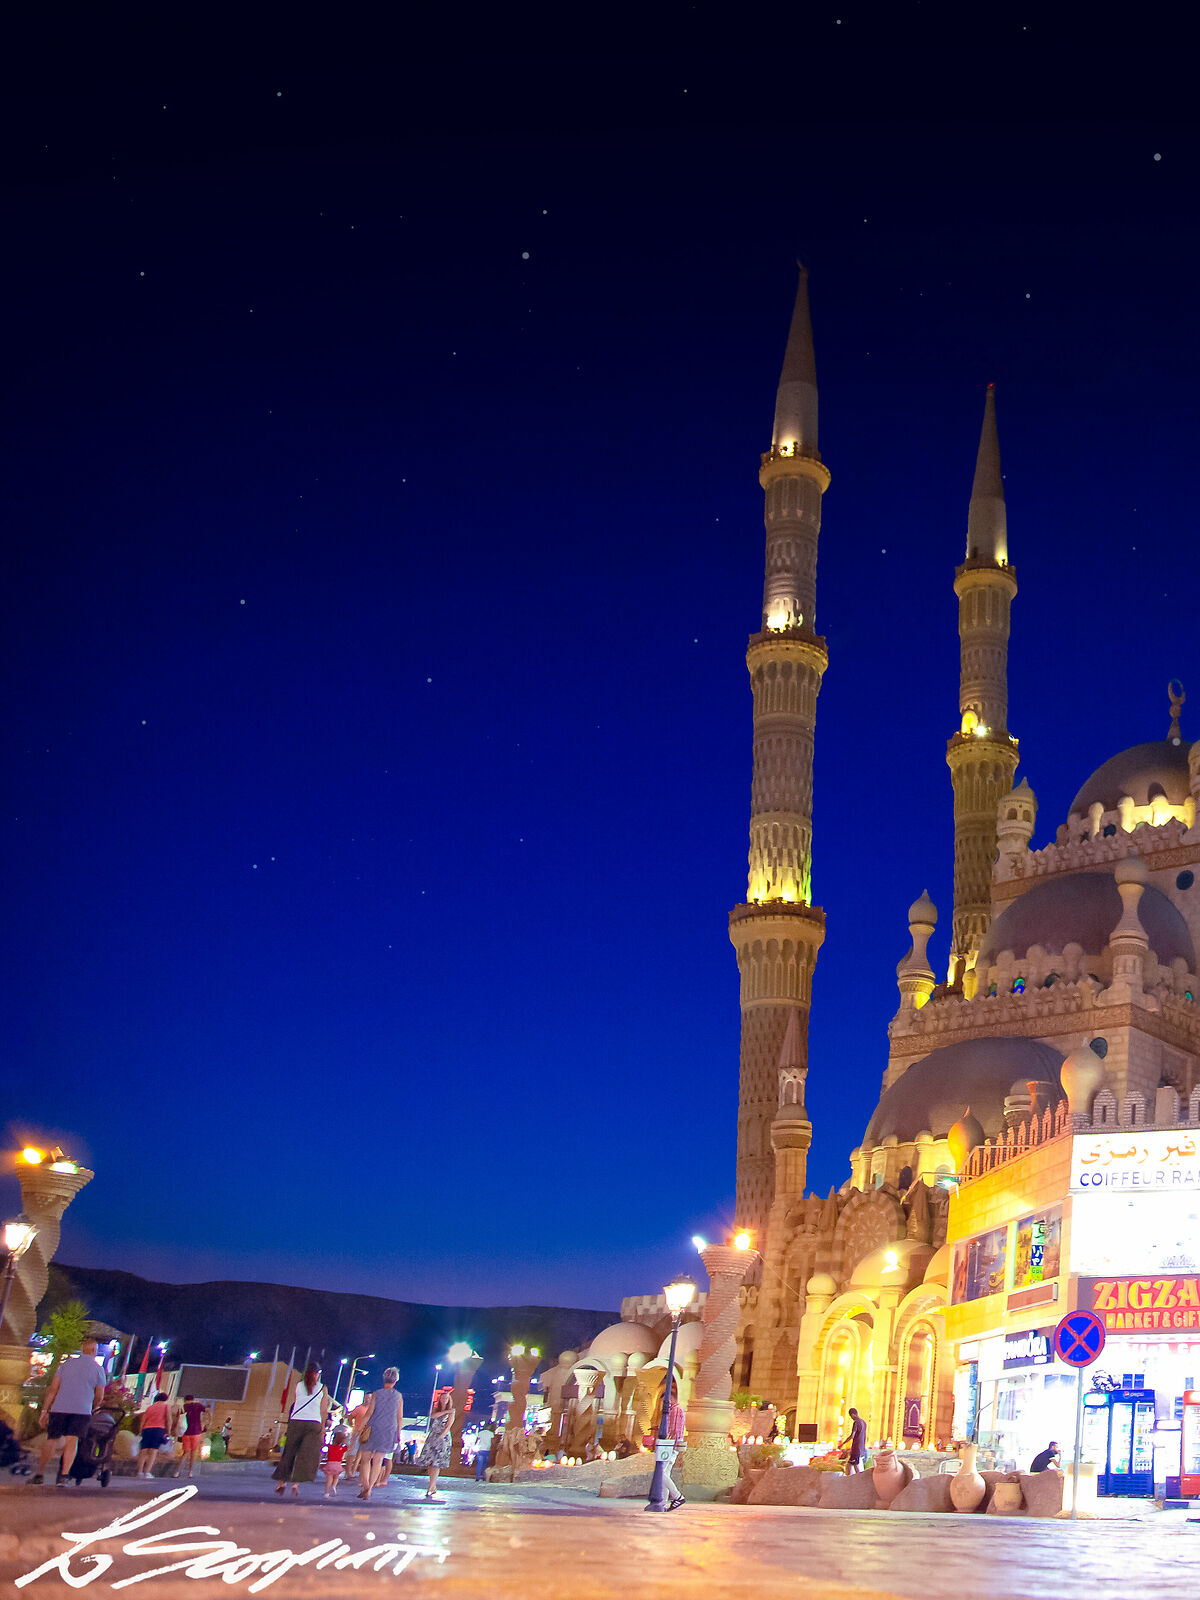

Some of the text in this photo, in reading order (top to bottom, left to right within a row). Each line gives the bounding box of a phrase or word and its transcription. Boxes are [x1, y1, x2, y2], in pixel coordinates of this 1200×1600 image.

[1080, 1171, 1165, 1186] COIFFEUR
[1105, 1311, 1161, 1329] MARKET
[1162, 1311, 1172, 1328] &
